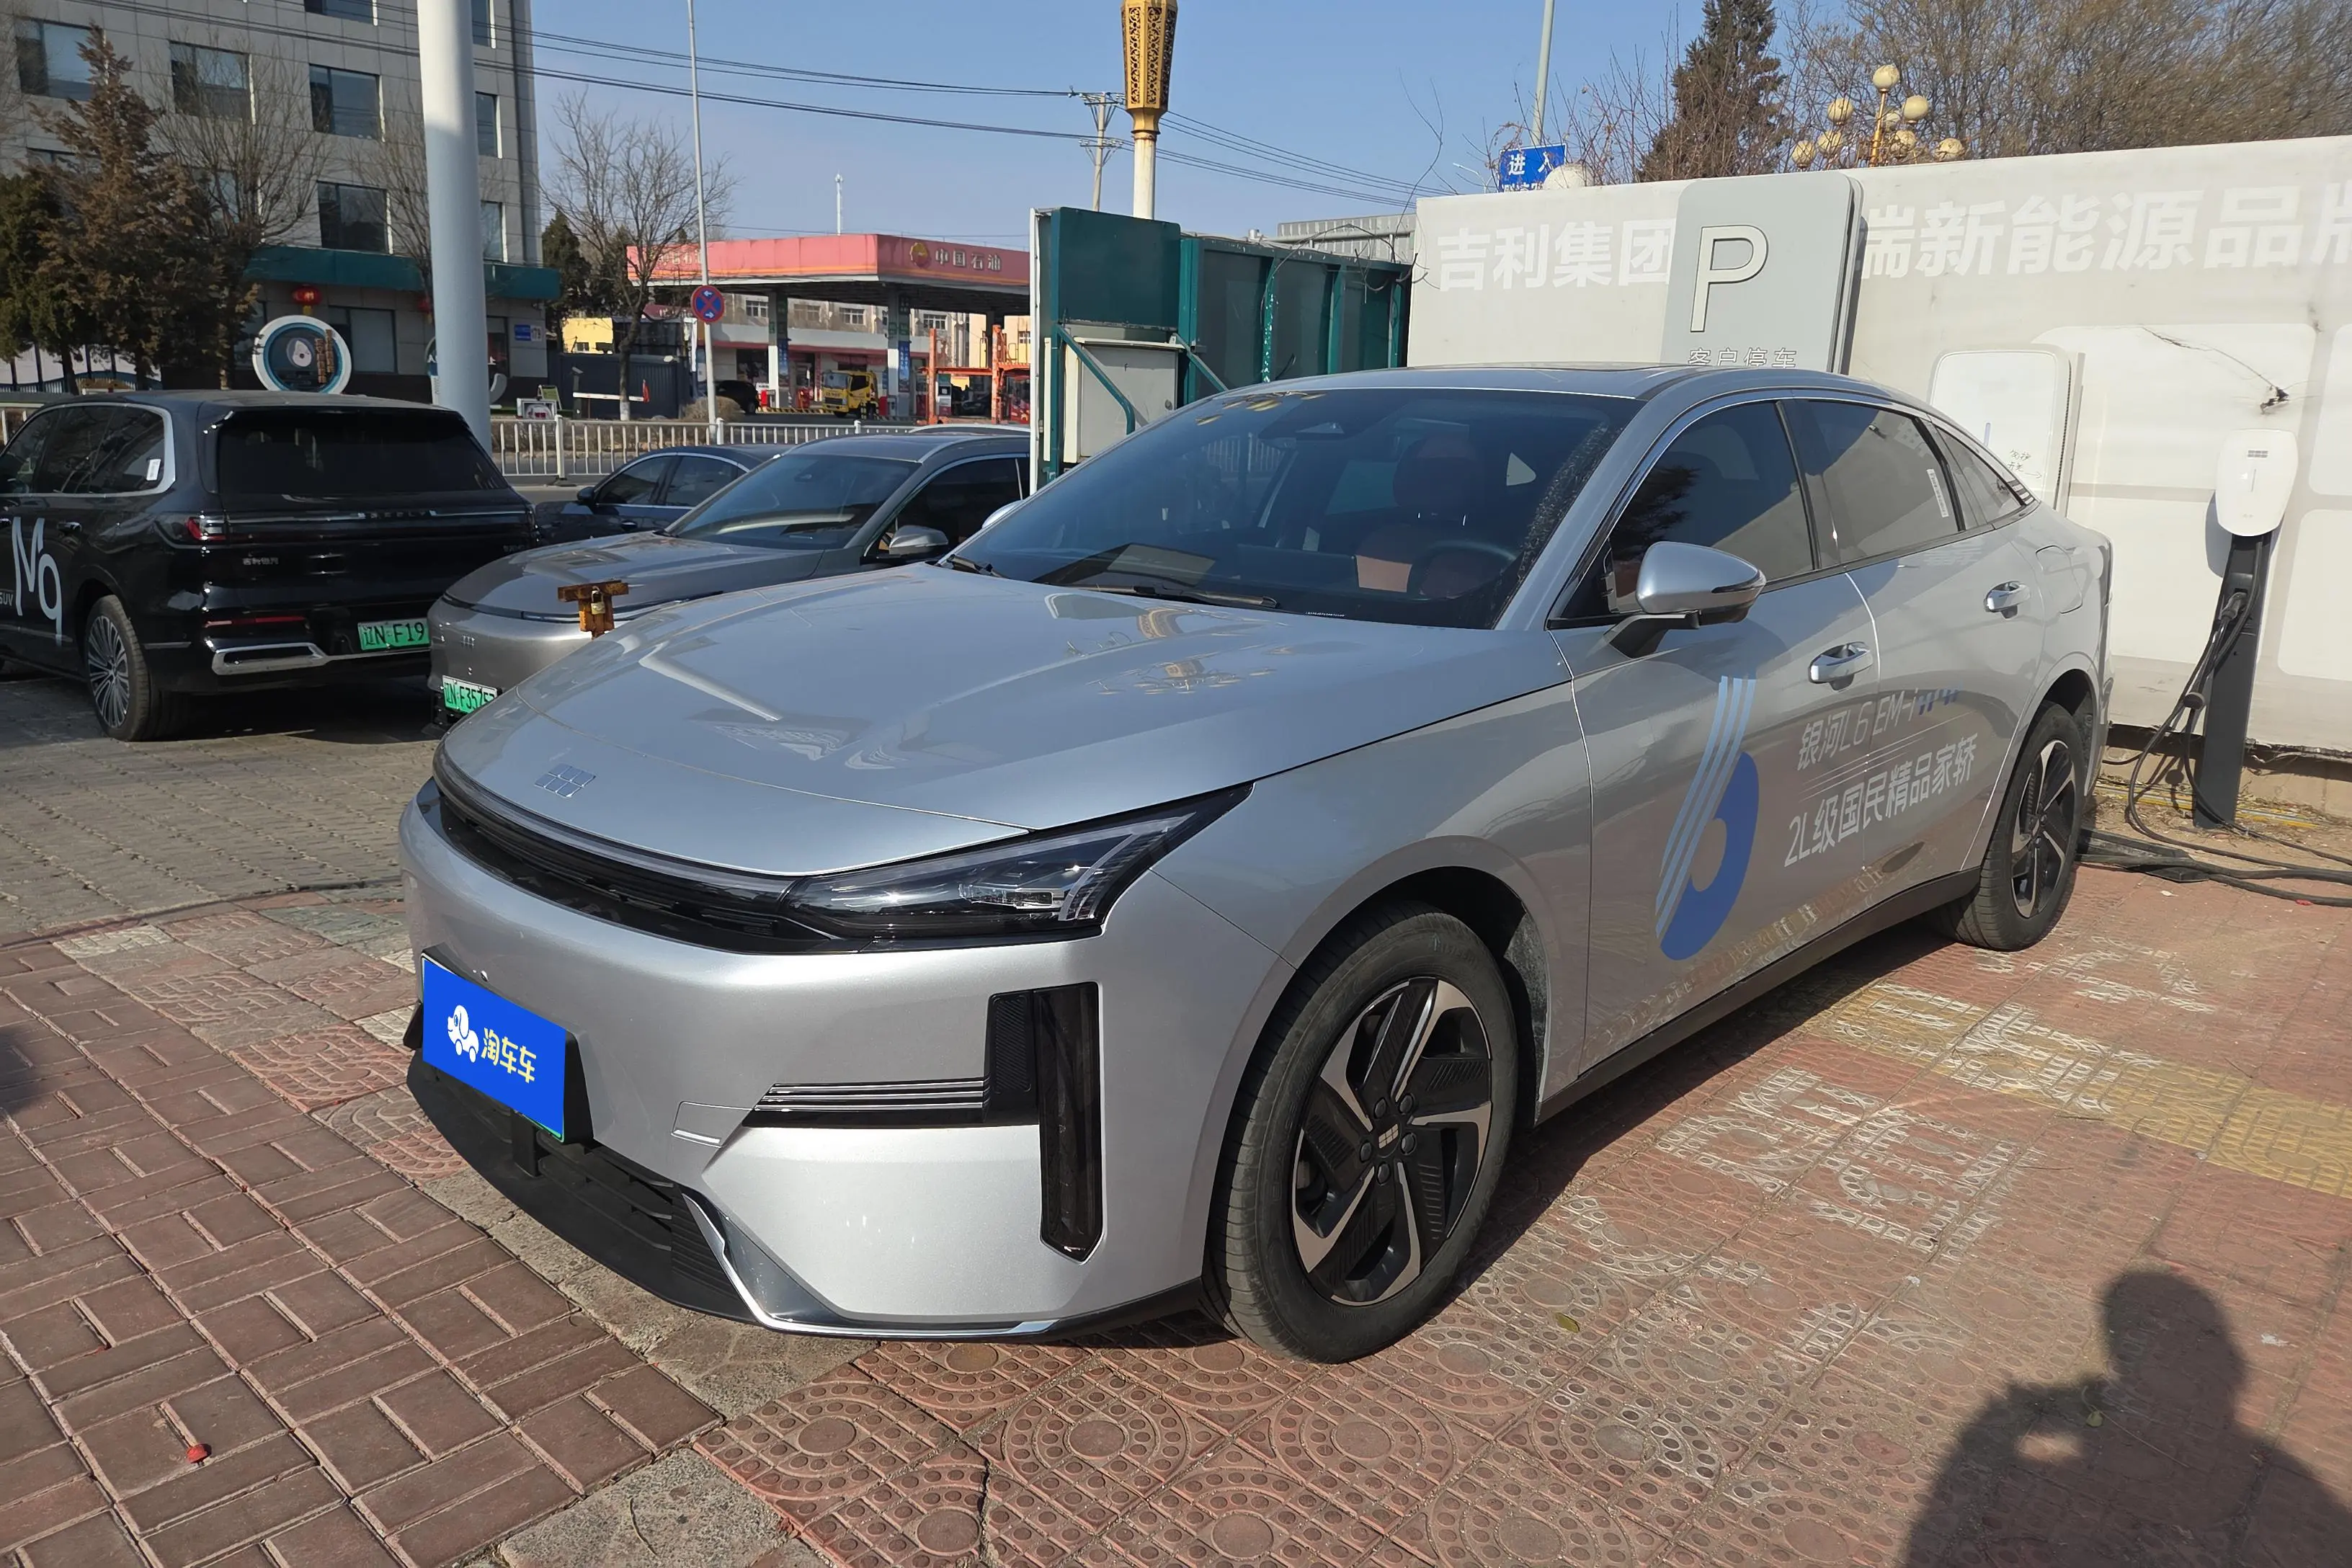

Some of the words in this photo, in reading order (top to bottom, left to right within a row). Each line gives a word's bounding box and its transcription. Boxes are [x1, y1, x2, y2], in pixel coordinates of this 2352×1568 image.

[1508, 152, 1553, 176] 进入
[935, 248, 1002, 271] 中国石油
[1437, 219, 1677, 291] 吉利集团
[1690, 224, 1769, 333] P
[1688, 347, 1797, 369] 客户停车
[1784, 733, 1978, 868] 2L级国民精品家轿
